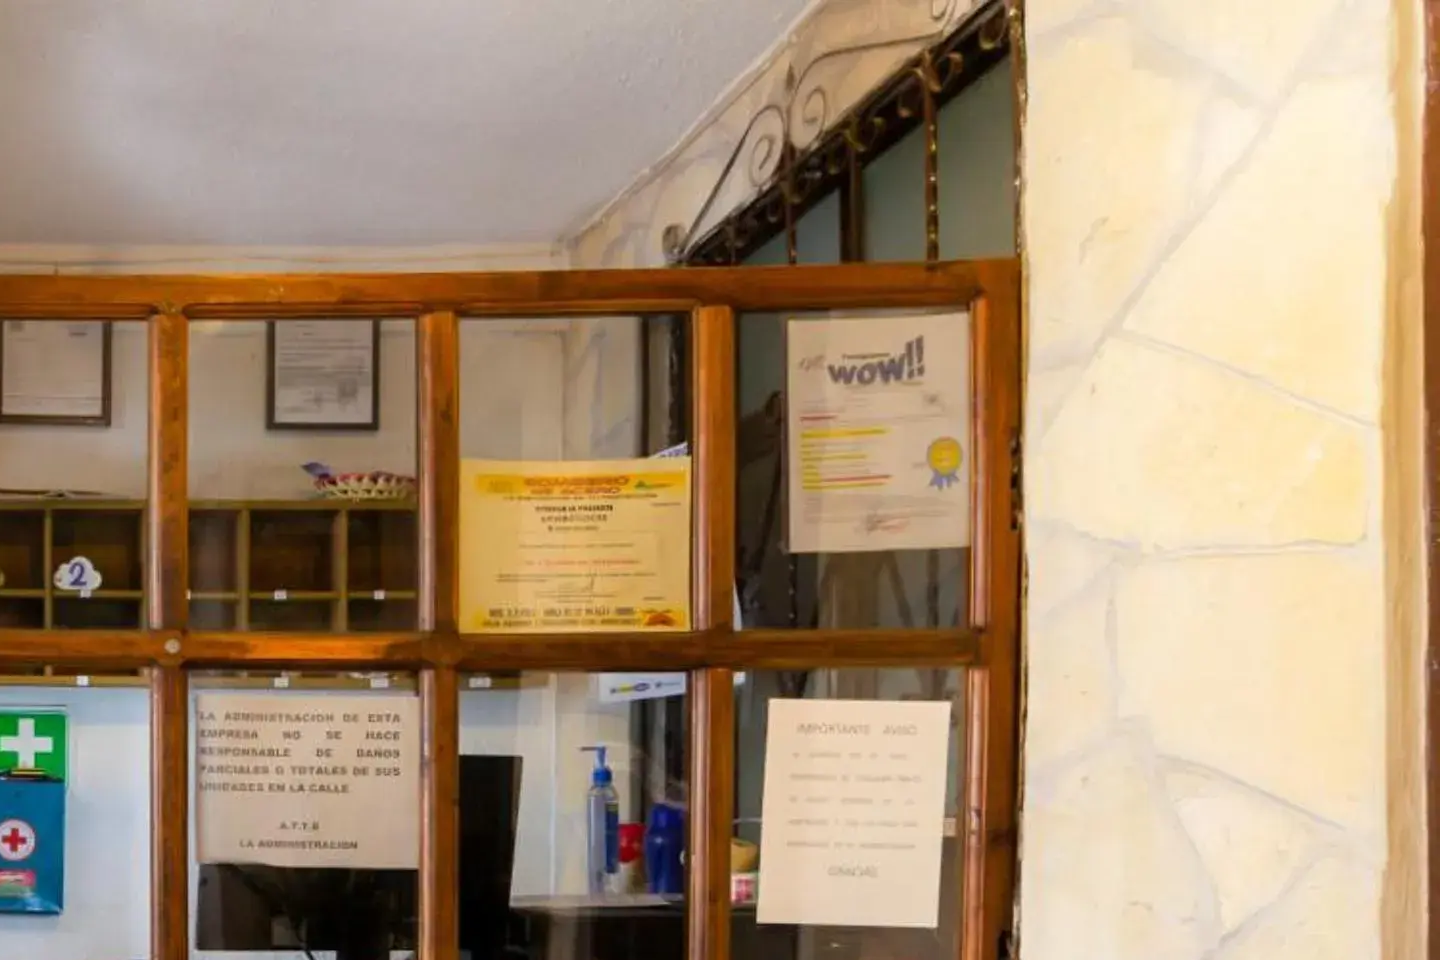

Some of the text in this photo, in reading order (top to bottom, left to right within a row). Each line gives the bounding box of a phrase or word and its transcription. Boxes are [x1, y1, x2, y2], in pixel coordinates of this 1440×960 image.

[68, 562, 87, 586] 2
[199, 729, 401, 741] EMPRESA NO SE HACE
[316, 748, 333, 758] DE
[290, 766, 348, 776] TOTALES
[352, 766, 369, 777] DE
[375, 766, 401, 777] SUS
[268, 783, 286, 792] EN
[308, 784, 350, 794] CALLE
[257, 839, 359, 850] ADMINISTRACION
